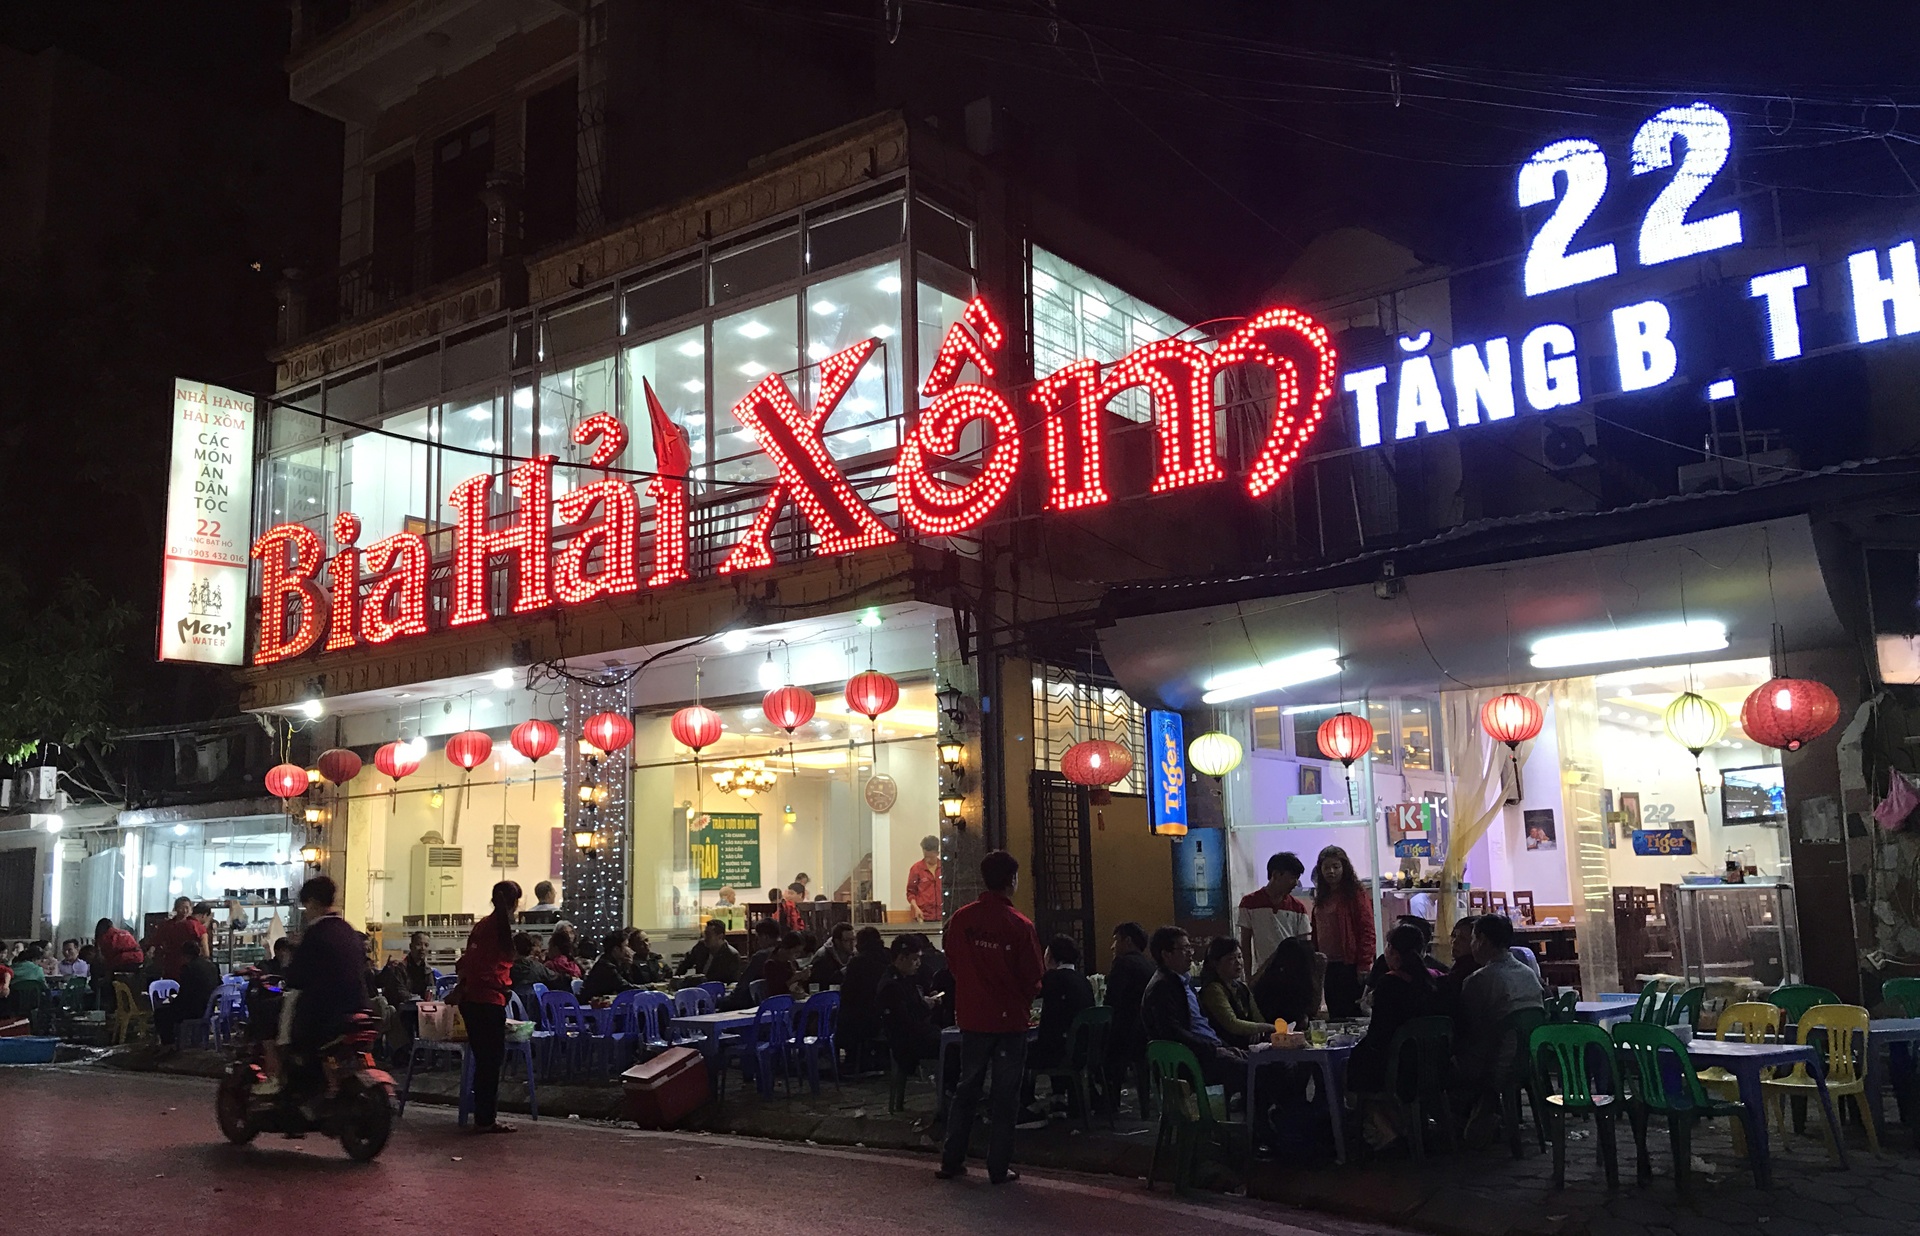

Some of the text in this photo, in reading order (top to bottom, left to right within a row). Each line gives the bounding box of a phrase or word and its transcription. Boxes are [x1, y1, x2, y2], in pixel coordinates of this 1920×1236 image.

[1516, 101, 1743, 298] 22
[1343, 331, 1582, 448] TĂNG
[176, 389, 253, 413] NHÀ HÀNG
[213, 411, 246, 430] XỒM
[198, 432, 230, 449] CÁC
[194, 448, 232, 465] MÓN
[201, 463, 223, 480] ĂN
[195, 480, 228, 497] DÂN
[194, 496, 228, 514] TỘC
[196, 519, 221, 538] 22
[251, 511, 428, 665] Bia
[448, 412, 690, 626] Hải
[188, 549, 210, 558] 0903
[212, 552, 227, 560] 432
[230, 554, 244, 562] 016
[192, 636, 226, 647] WATER
[1162, 733, 1183, 815] Tiger
[1400, 805, 1428, 830] K+
[1643, 804, 1675, 823] 22
[1402, 843, 1428, 857] Tiger
[1644, 833, 1686, 853] Tiger
[690, 836, 719, 879] TRÂU
